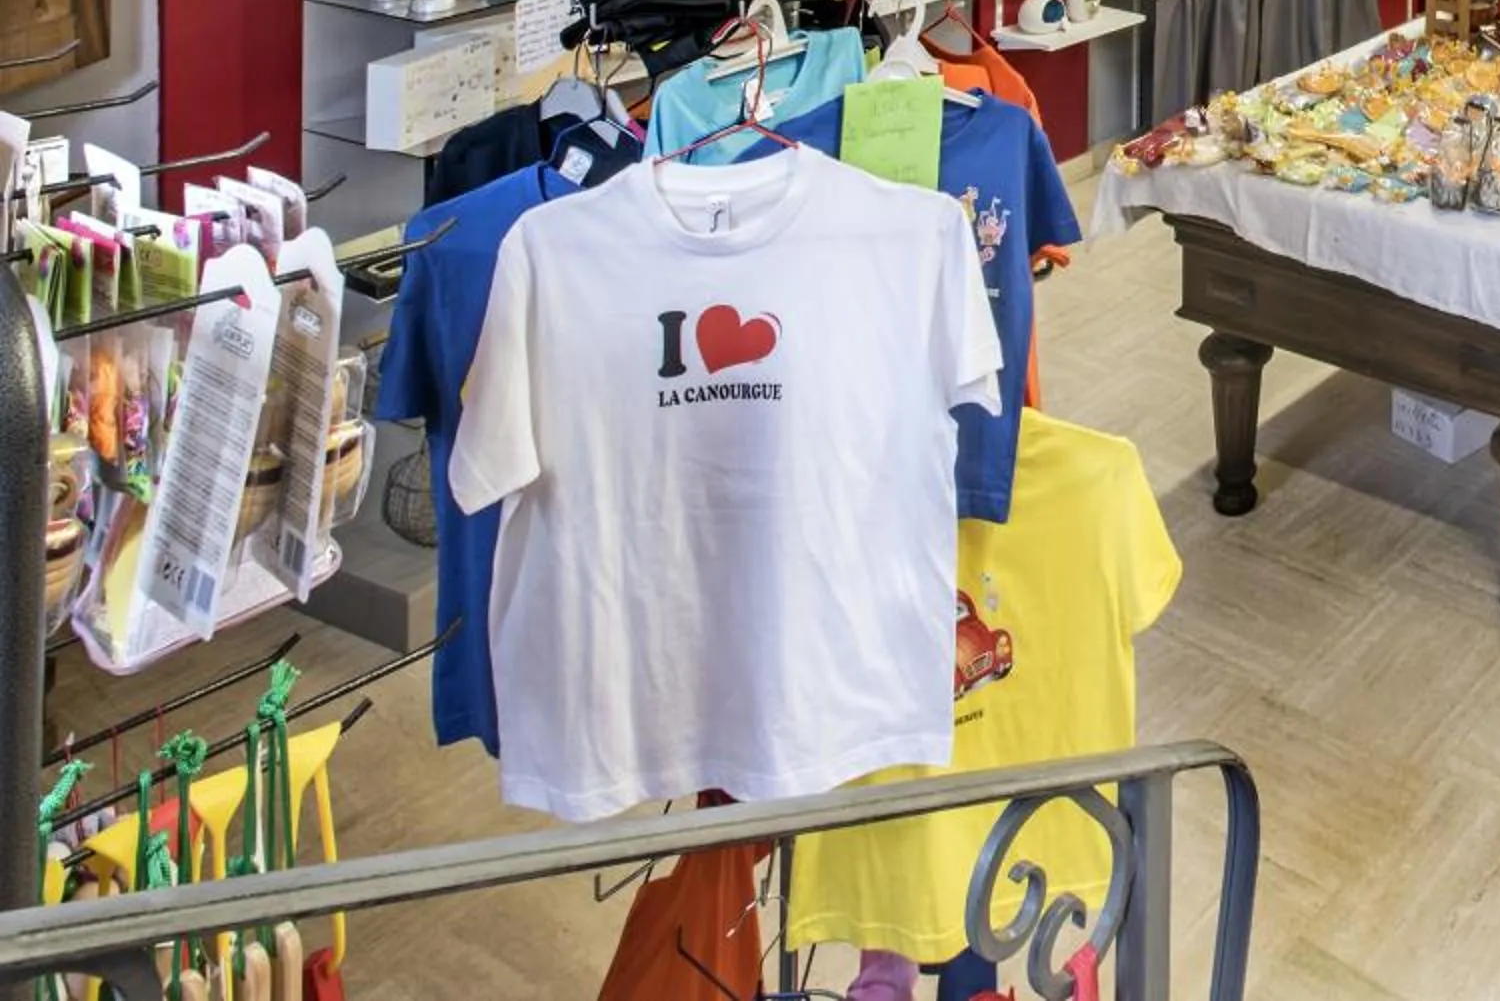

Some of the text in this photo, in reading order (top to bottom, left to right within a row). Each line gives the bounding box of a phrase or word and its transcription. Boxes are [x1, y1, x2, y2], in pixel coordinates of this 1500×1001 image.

[657, 310, 687, 378] I
[658, 383, 782, 407] LA CANOURGUE
